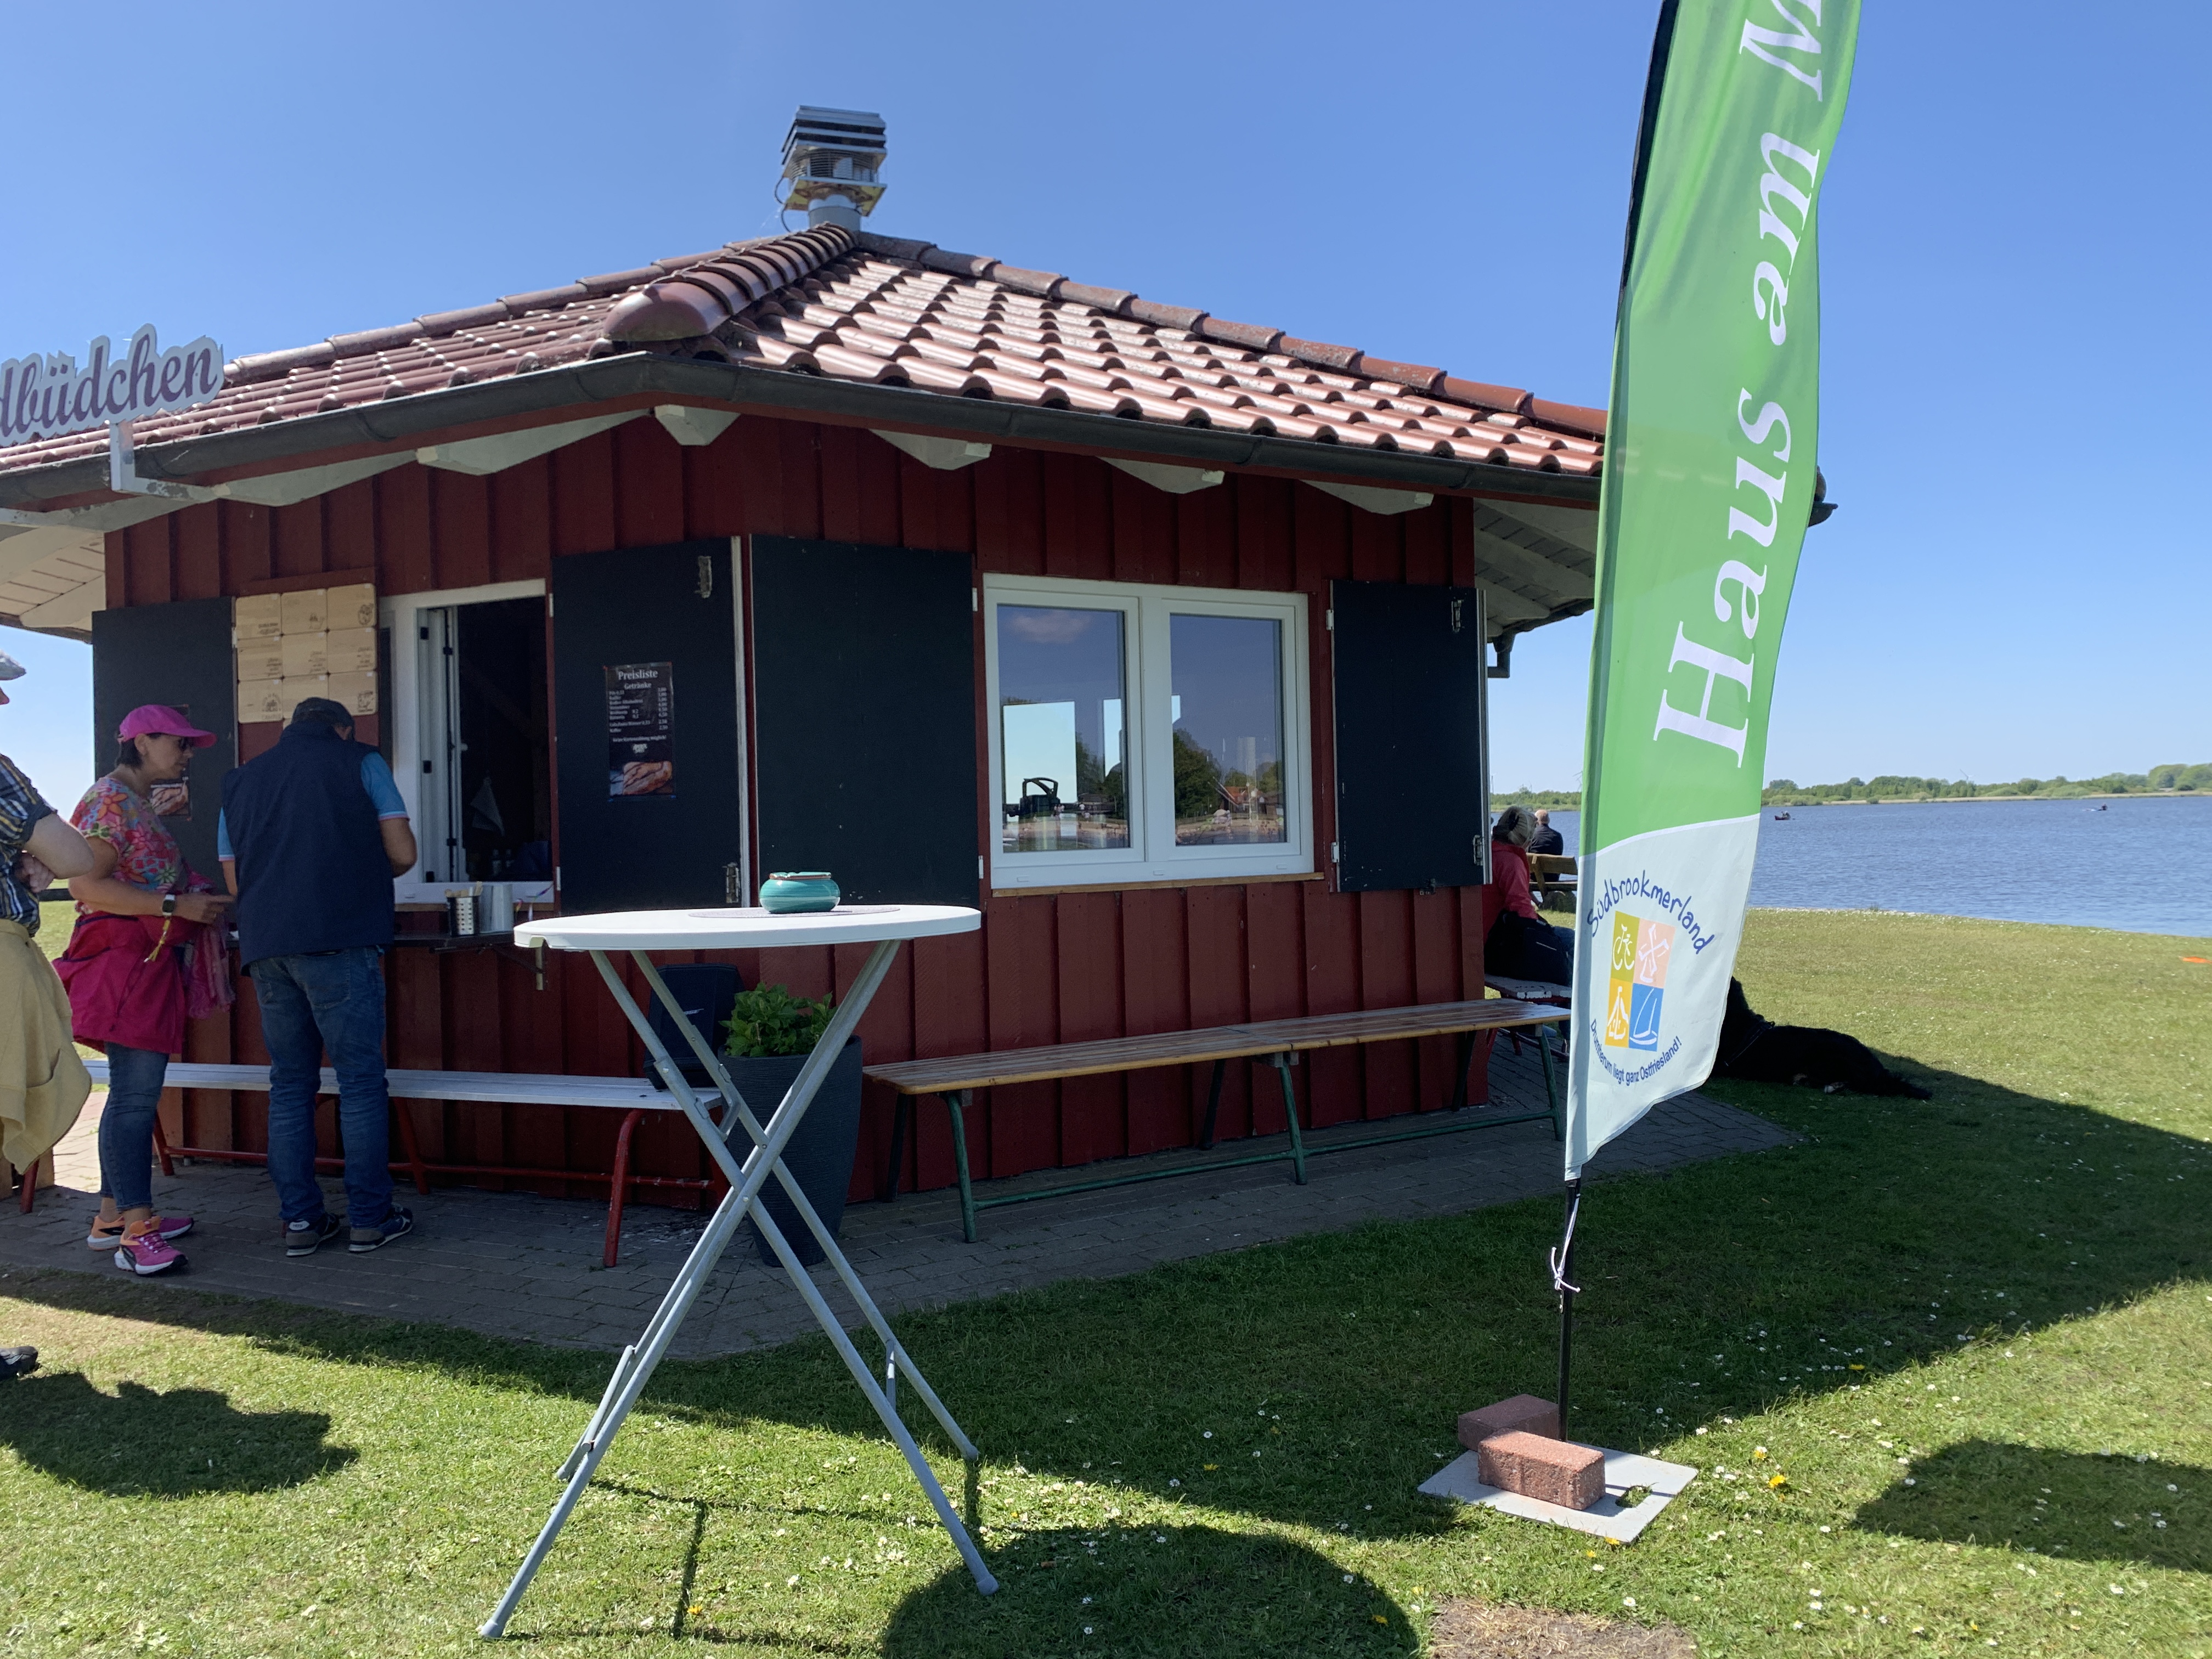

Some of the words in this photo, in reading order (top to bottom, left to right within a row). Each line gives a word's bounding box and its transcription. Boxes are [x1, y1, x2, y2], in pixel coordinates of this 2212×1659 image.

[1653, 387, 1792, 769] Haus
[1753, 132, 1821, 346] am
[618, 669, 658, 680] Preisliste
[624, 682, 652, 690] Getränke
[1587, 870, 1715, 955] Südbrookmerland
[1590, 1019, 1612, 1075] Drumherum
[1613, 1063, 1625, 1085] liegt
[1626, 1071, 1639, 1086] ganz
[1640, 1035, 1682, 1075] Ostfriesland!
